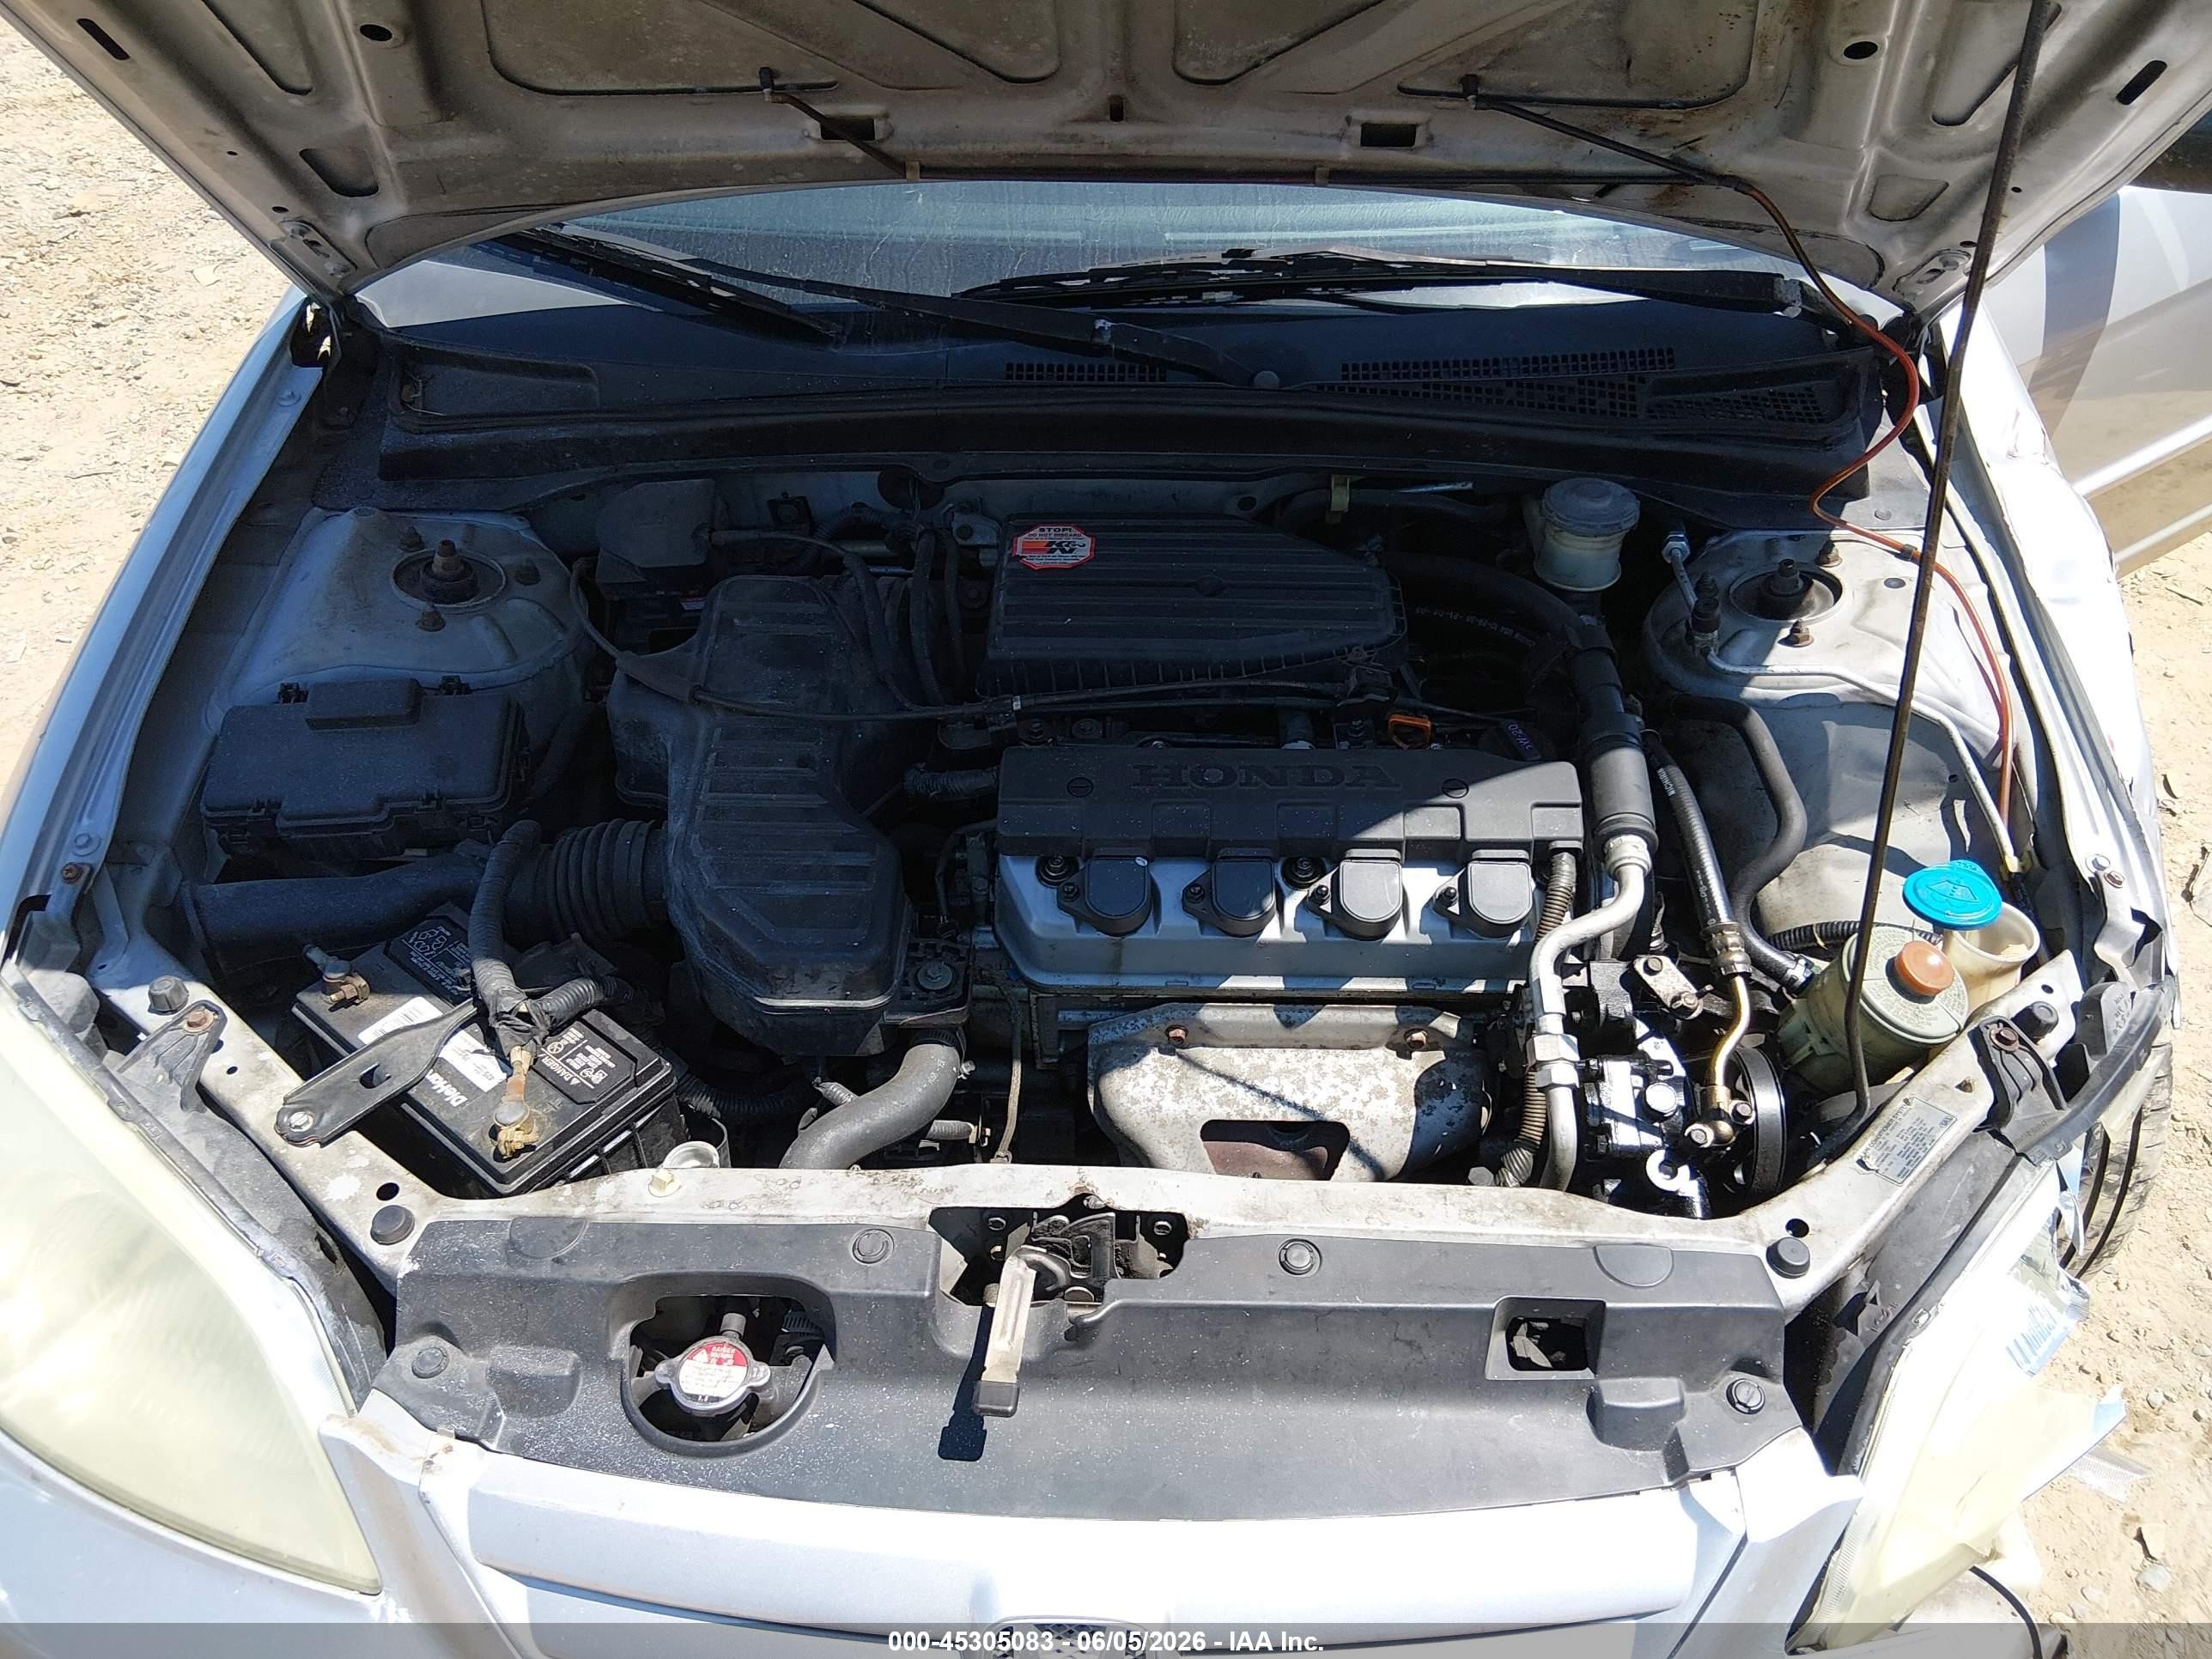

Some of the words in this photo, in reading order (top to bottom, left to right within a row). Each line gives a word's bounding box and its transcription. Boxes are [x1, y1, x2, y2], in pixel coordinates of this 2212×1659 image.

[1129, 763, 1402, 791] HONDA
[1656, 768, 1676, 797] NICHIRIN
[425, 1069, 468, 1108] DieHar
[1869, 1115, 1894, 1147] CONDITIONER
